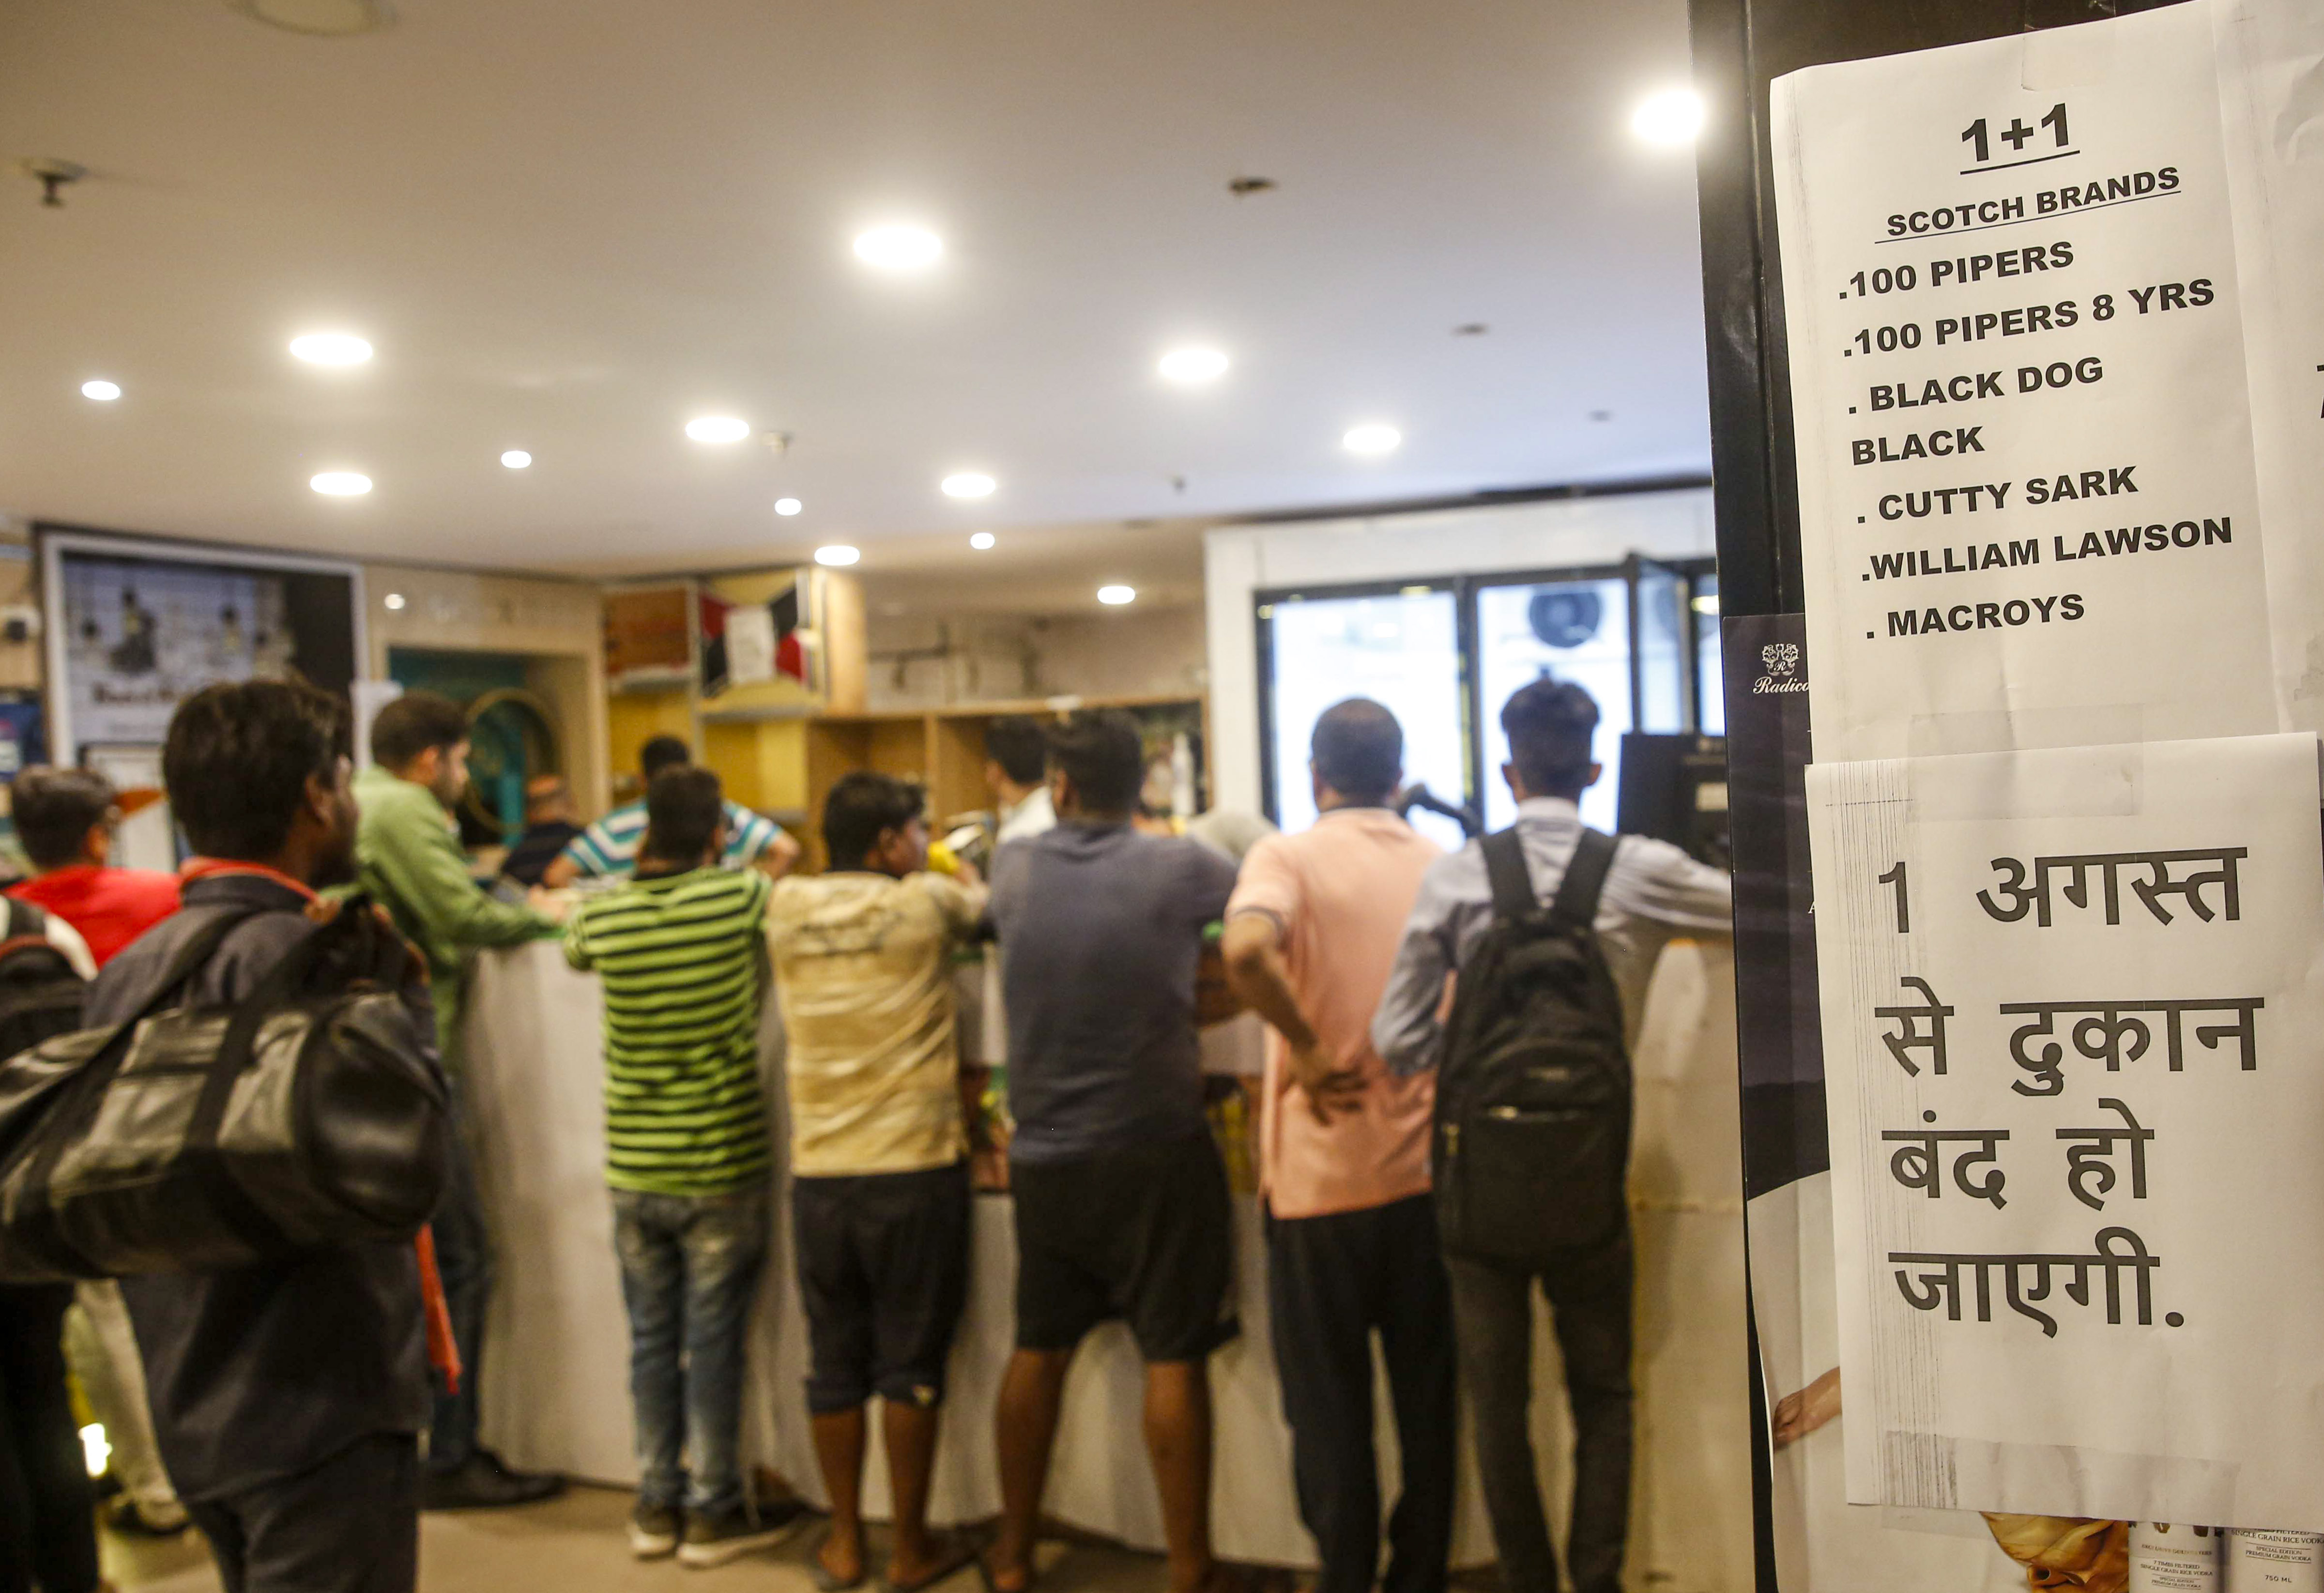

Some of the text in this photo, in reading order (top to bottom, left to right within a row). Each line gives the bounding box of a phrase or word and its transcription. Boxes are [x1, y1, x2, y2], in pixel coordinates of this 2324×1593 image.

[1961, 103, 2069, 162] 1+1
[1887, 167, 2180, 236] SCOTCH BRANDS
[1930, 242, 2074, 287] PIPERS
[1935, 301, 2079, 345] PIPERS
[2092, 294, 2115, 322] 8
[2128, 278, 2215, 314] YRS
[1870, 371, 2005, 411] BLACK
[2017, 357, 2103, 393] DOG
[1851, 426, 1985, 465] BLACK
[1879, 482, 2012, 520] CUTTY
[2026, 466, 2139, 505] SARK
[2054, 517, 2232, 561] LAWSON
[1887, 594, 2085, 637] MACROYS
[1879, 846, 2248, 934] 1 अगस्त
[1874, 976, 2265, 1097] से दुकान
[1881, 1098, 2155, 1211] बंद हो
[1888, 1226, 2184, 1339] जाएगी.
[2231, 1529, 2257, 1538] SINGLE
[2258, 1533, 2281, 1542] GRAIN
